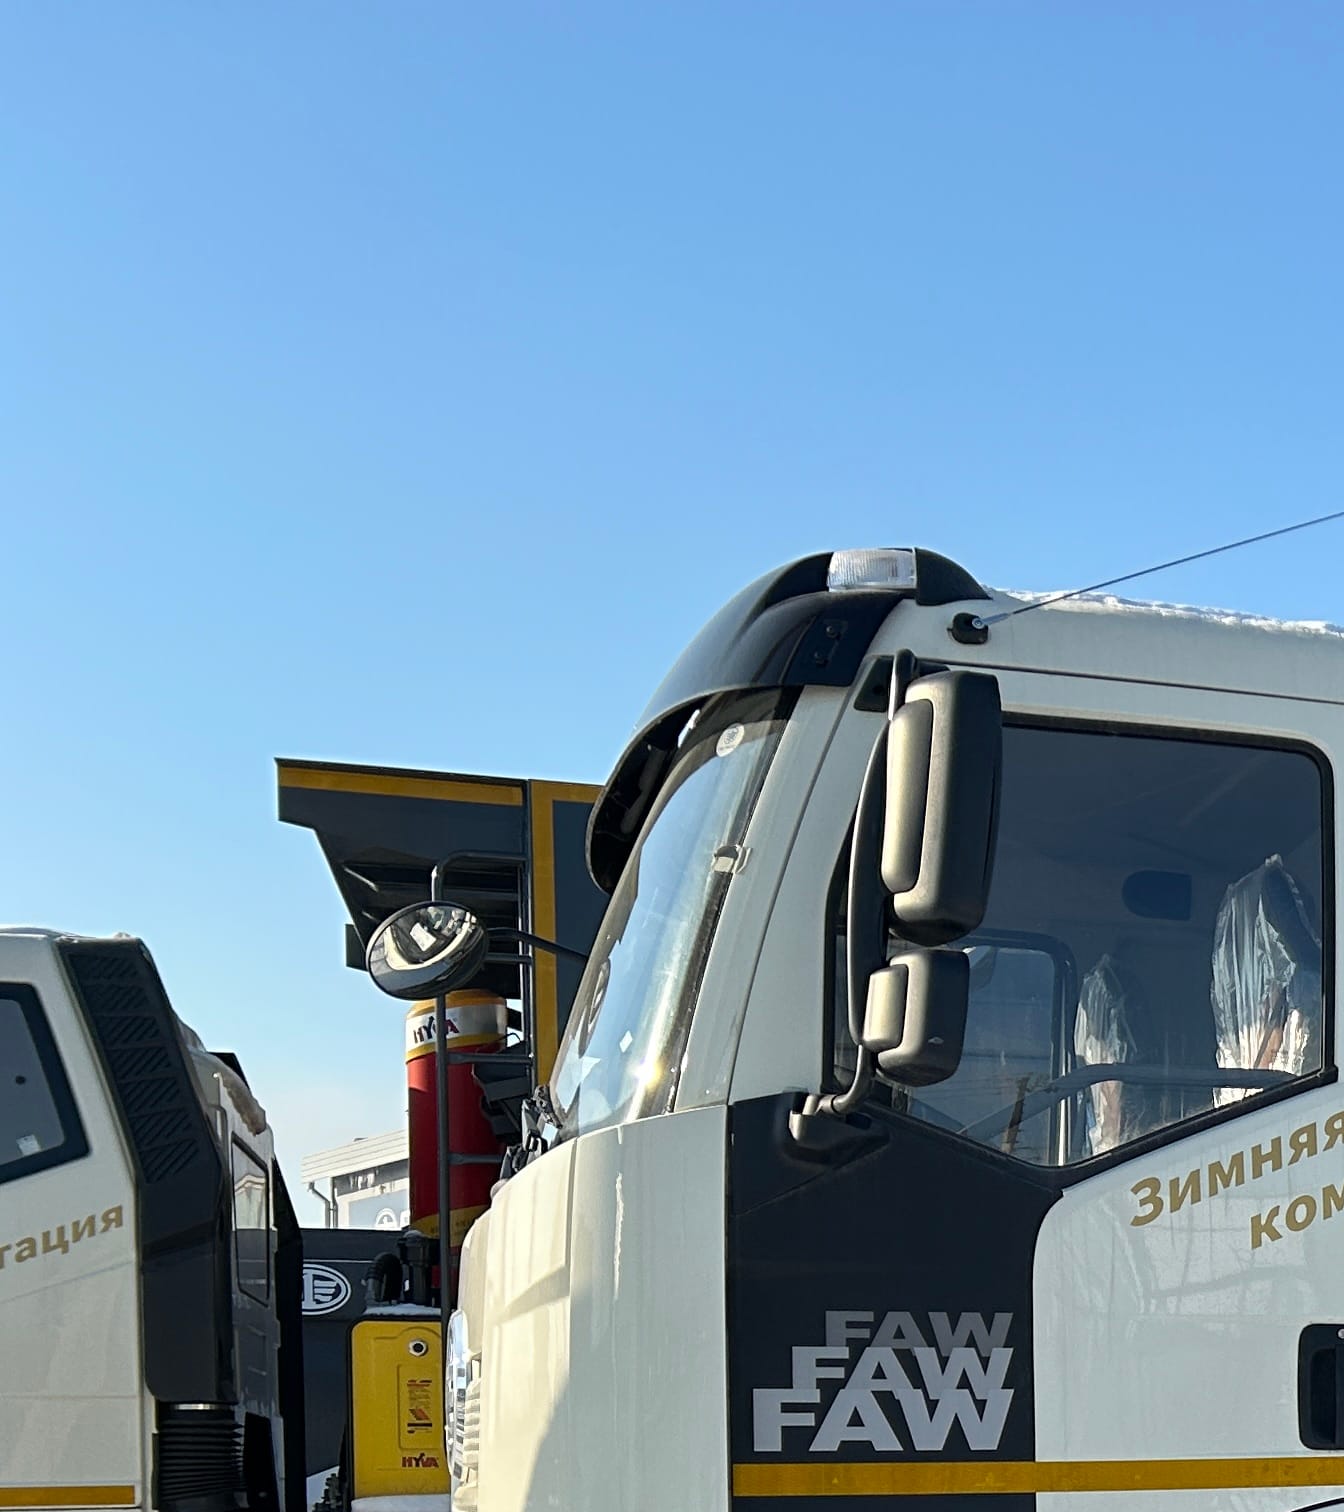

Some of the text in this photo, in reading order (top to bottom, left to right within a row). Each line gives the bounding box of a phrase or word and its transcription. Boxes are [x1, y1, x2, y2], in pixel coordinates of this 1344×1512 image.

[413, 1015, 460, 1044] HYA
[825, 1310, 1014, 1357] FAW
[792, 1346, 1014, 1400] FAW
[753, 1388, 1015, 1452] FAW
